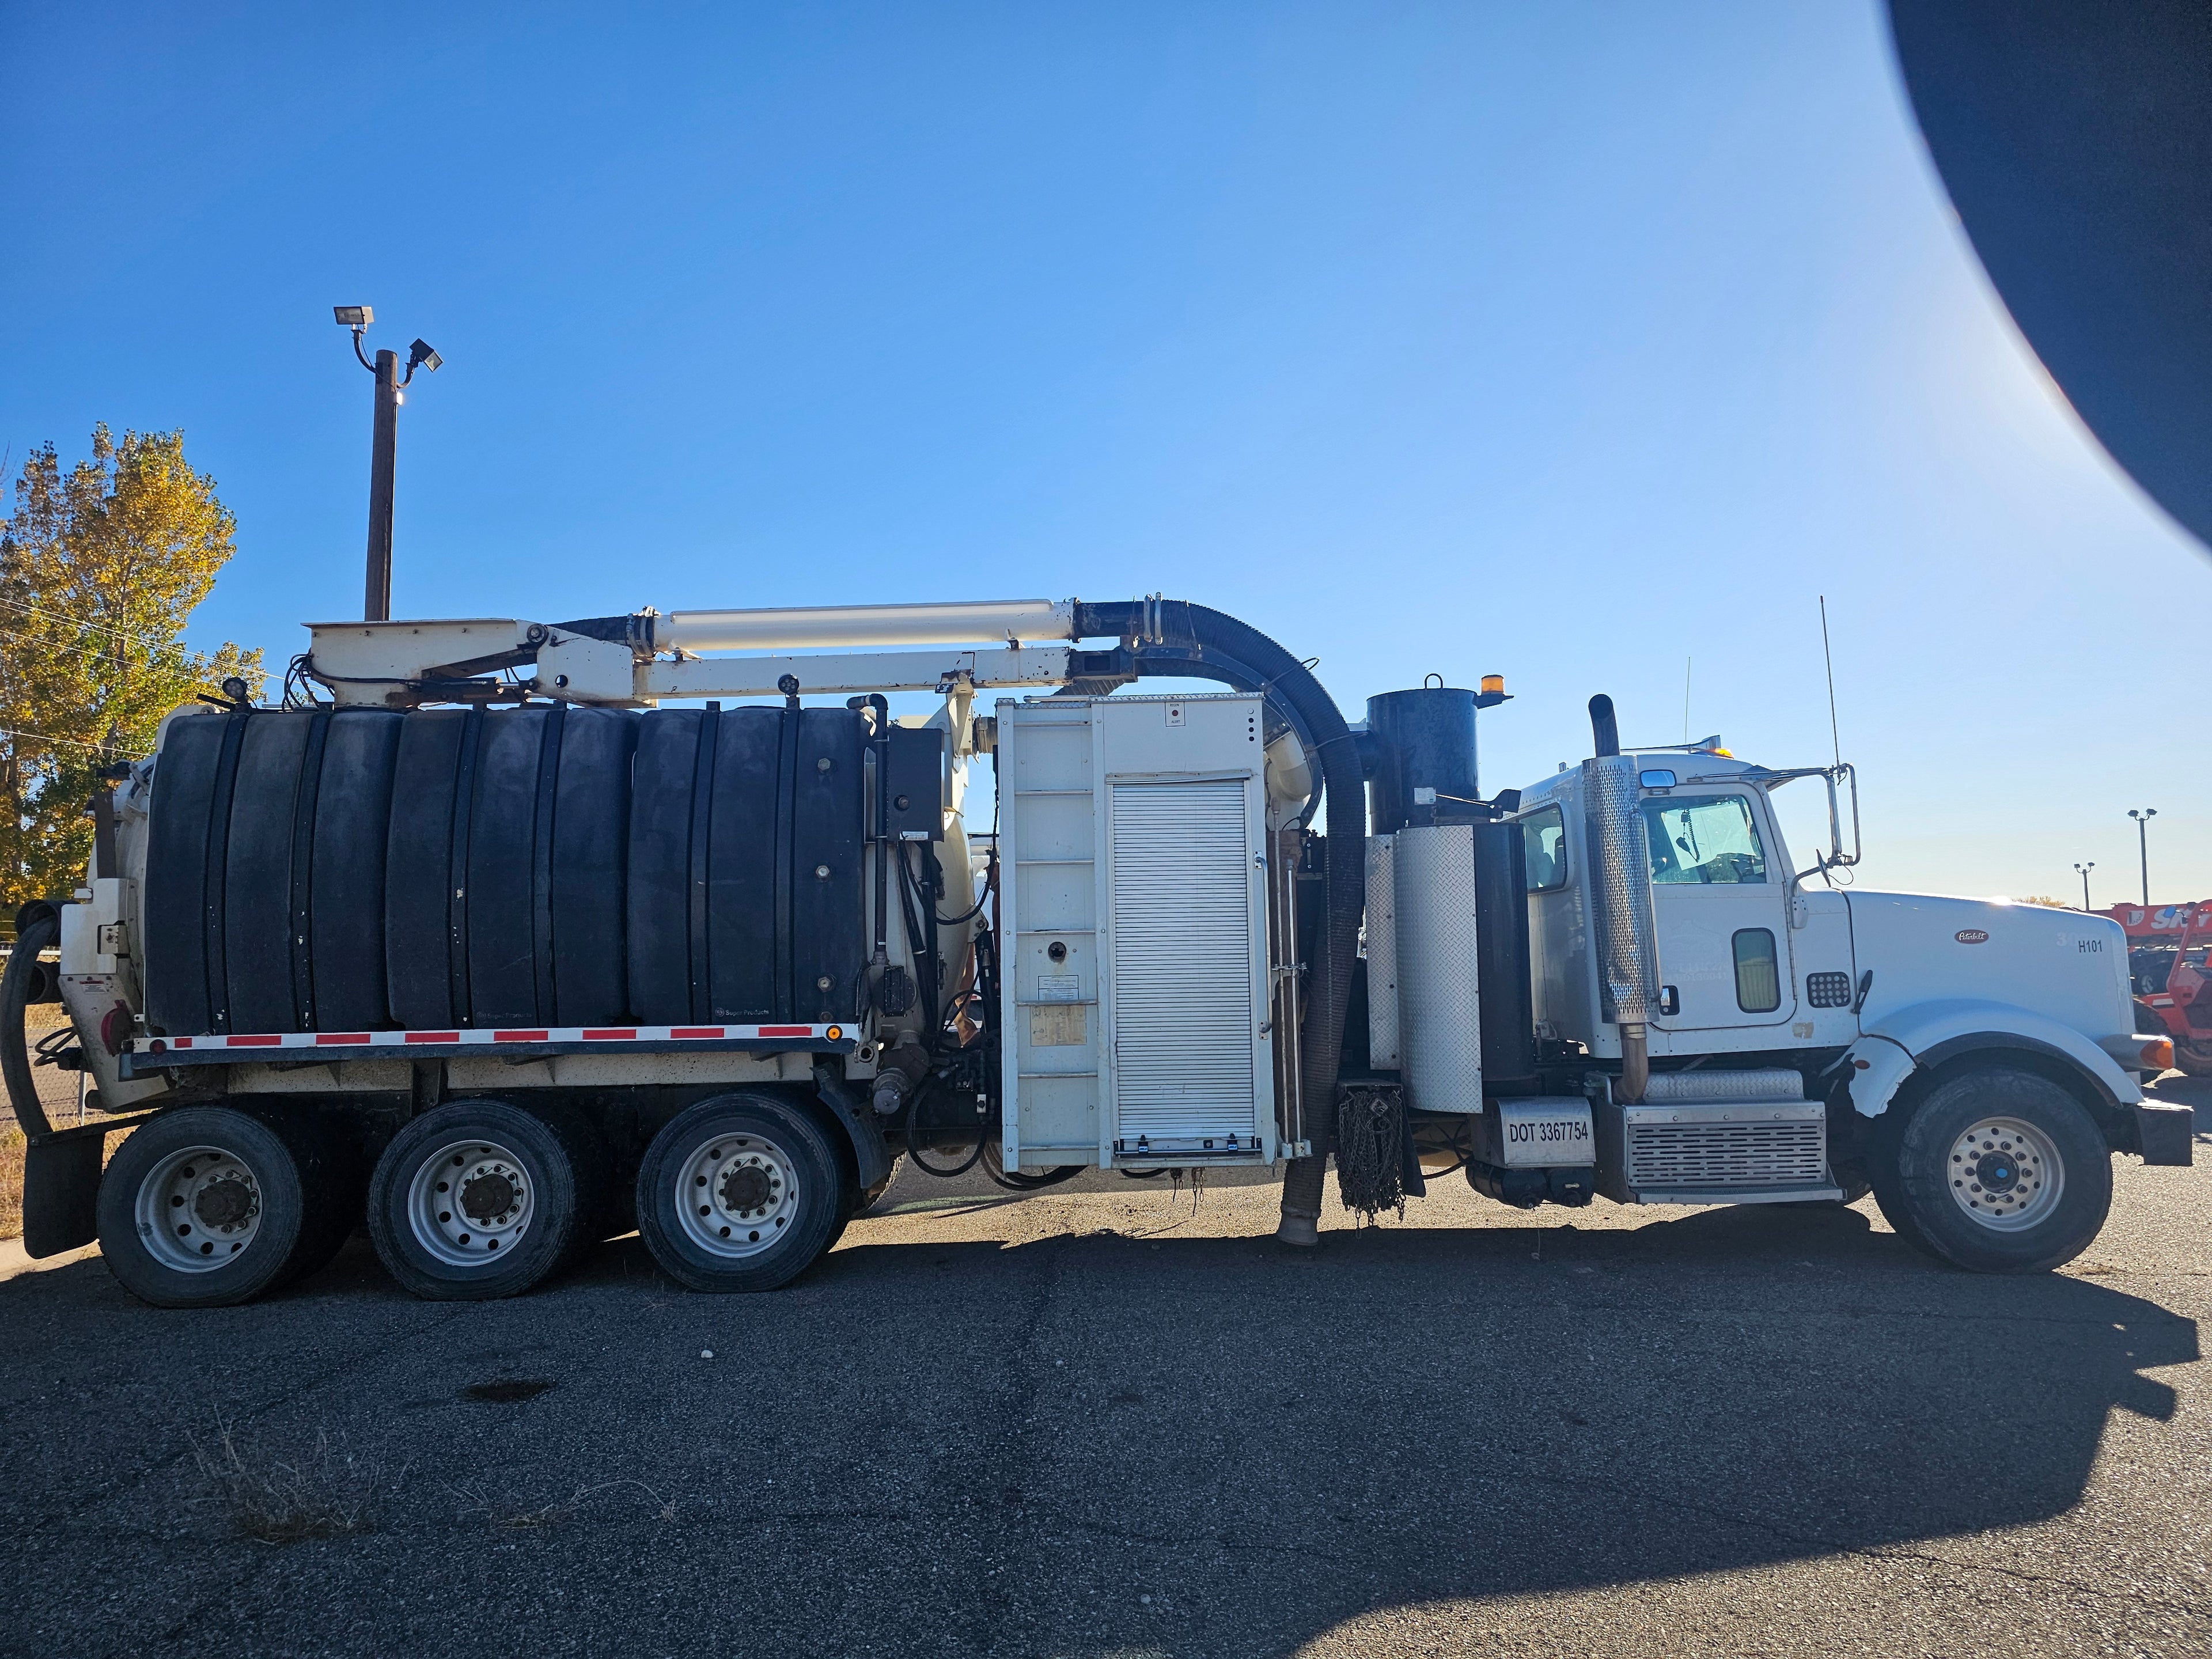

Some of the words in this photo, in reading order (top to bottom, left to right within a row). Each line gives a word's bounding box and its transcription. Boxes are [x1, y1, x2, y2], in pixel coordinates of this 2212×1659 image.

[1959, 932, 1987, 941] Peterbilt
[2078, 940, 2103, 953] H101
[1509, 1123, 1536, 1142] DOT
[1539, 1121, 1588, 1141] 3367754
